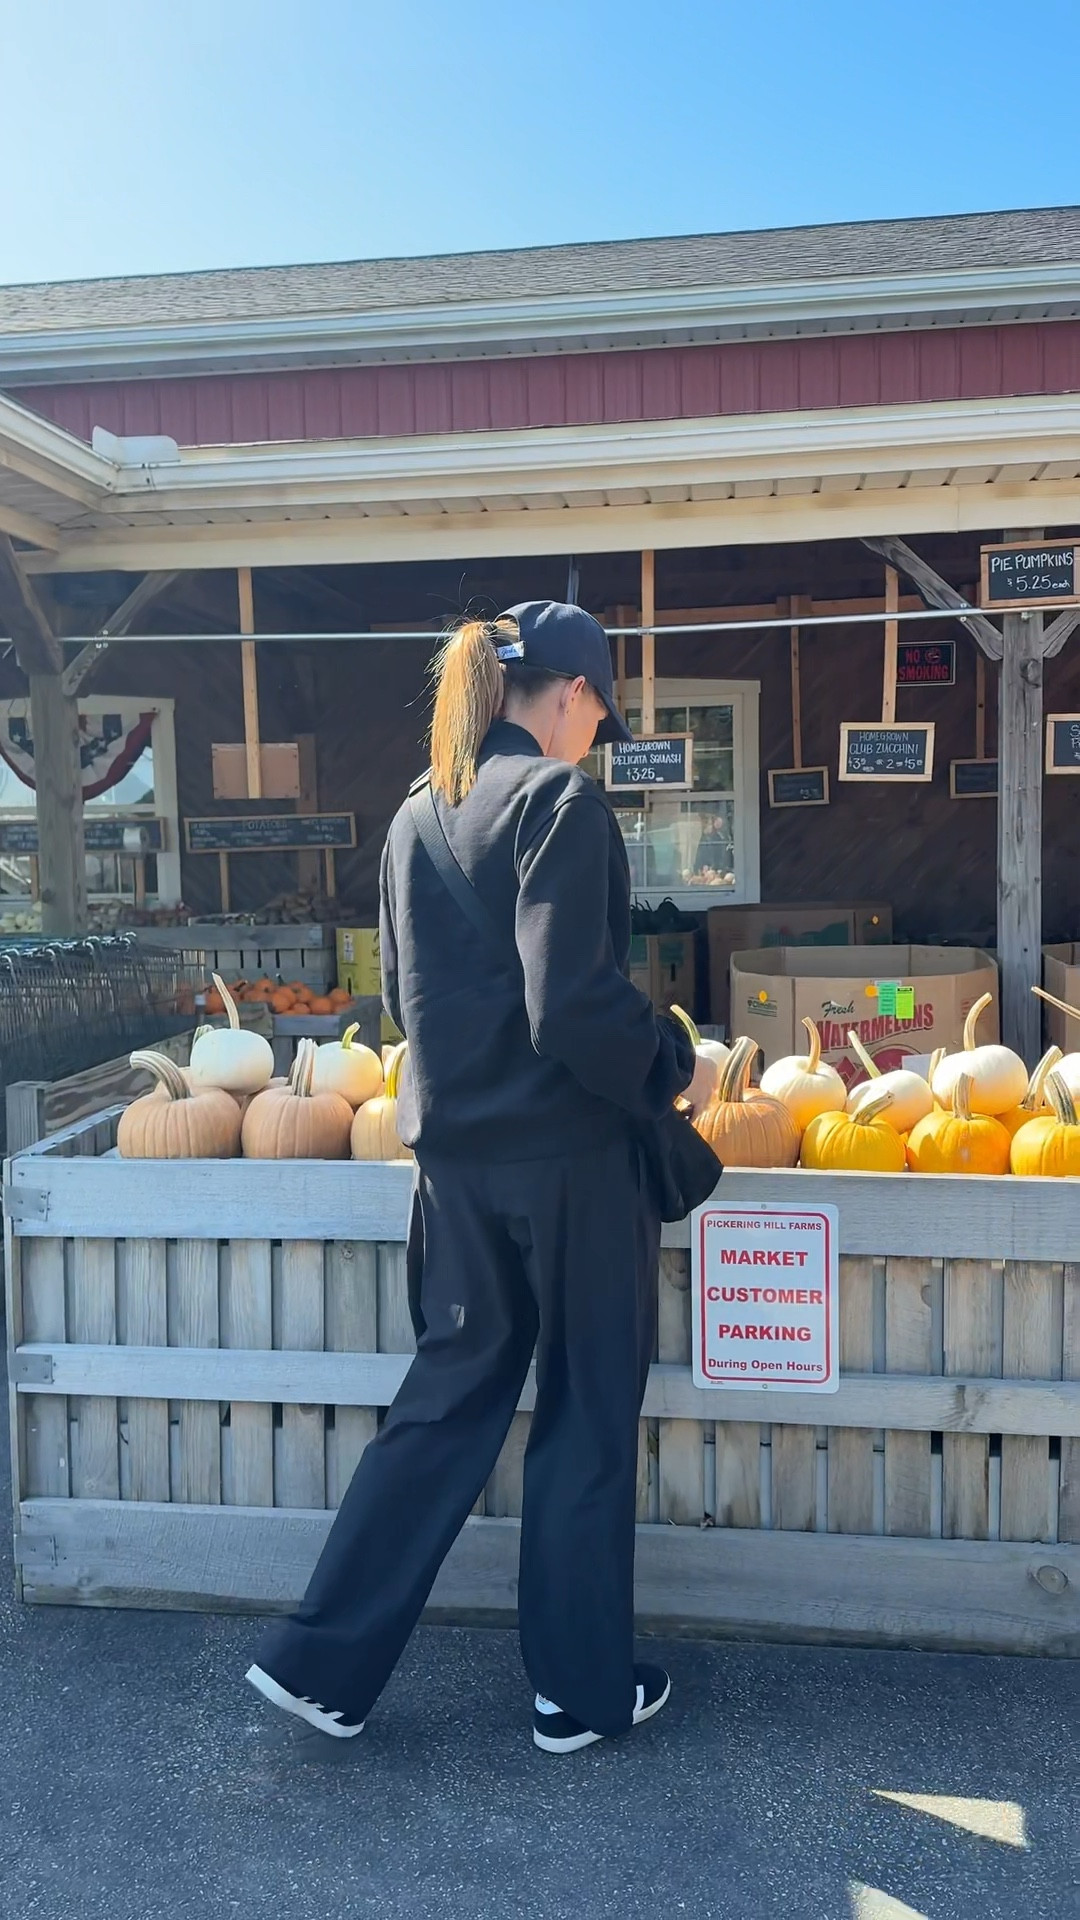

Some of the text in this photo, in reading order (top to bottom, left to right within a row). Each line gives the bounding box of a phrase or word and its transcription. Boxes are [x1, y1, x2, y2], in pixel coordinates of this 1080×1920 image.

[991, 551, 1073, 573] PIE PUMPKINS
[905, 649, 920, 663] NO
[898, 664, 949, 681] SMOKING
[859, 731, 909, 742] HOMEGROWN
[618, 741, 671, 753] HOMEGROWN
[849, 743, 919, 754] CLUB ZUCCHINI
[612, 753, 681, 766] DELICATA SQUASH
[821, 1000, 855, 1018] Fresh
[707, 1220, 822, 1231] PICKERING HILL FARMS
[720, 1249, 808, 1267] MARKET
[706, 1286, 823, 1304] CUSTOMER
[718, 1324, 812, 1341] PARKING
[708, 1358, 823, 1372] During Open Hours
